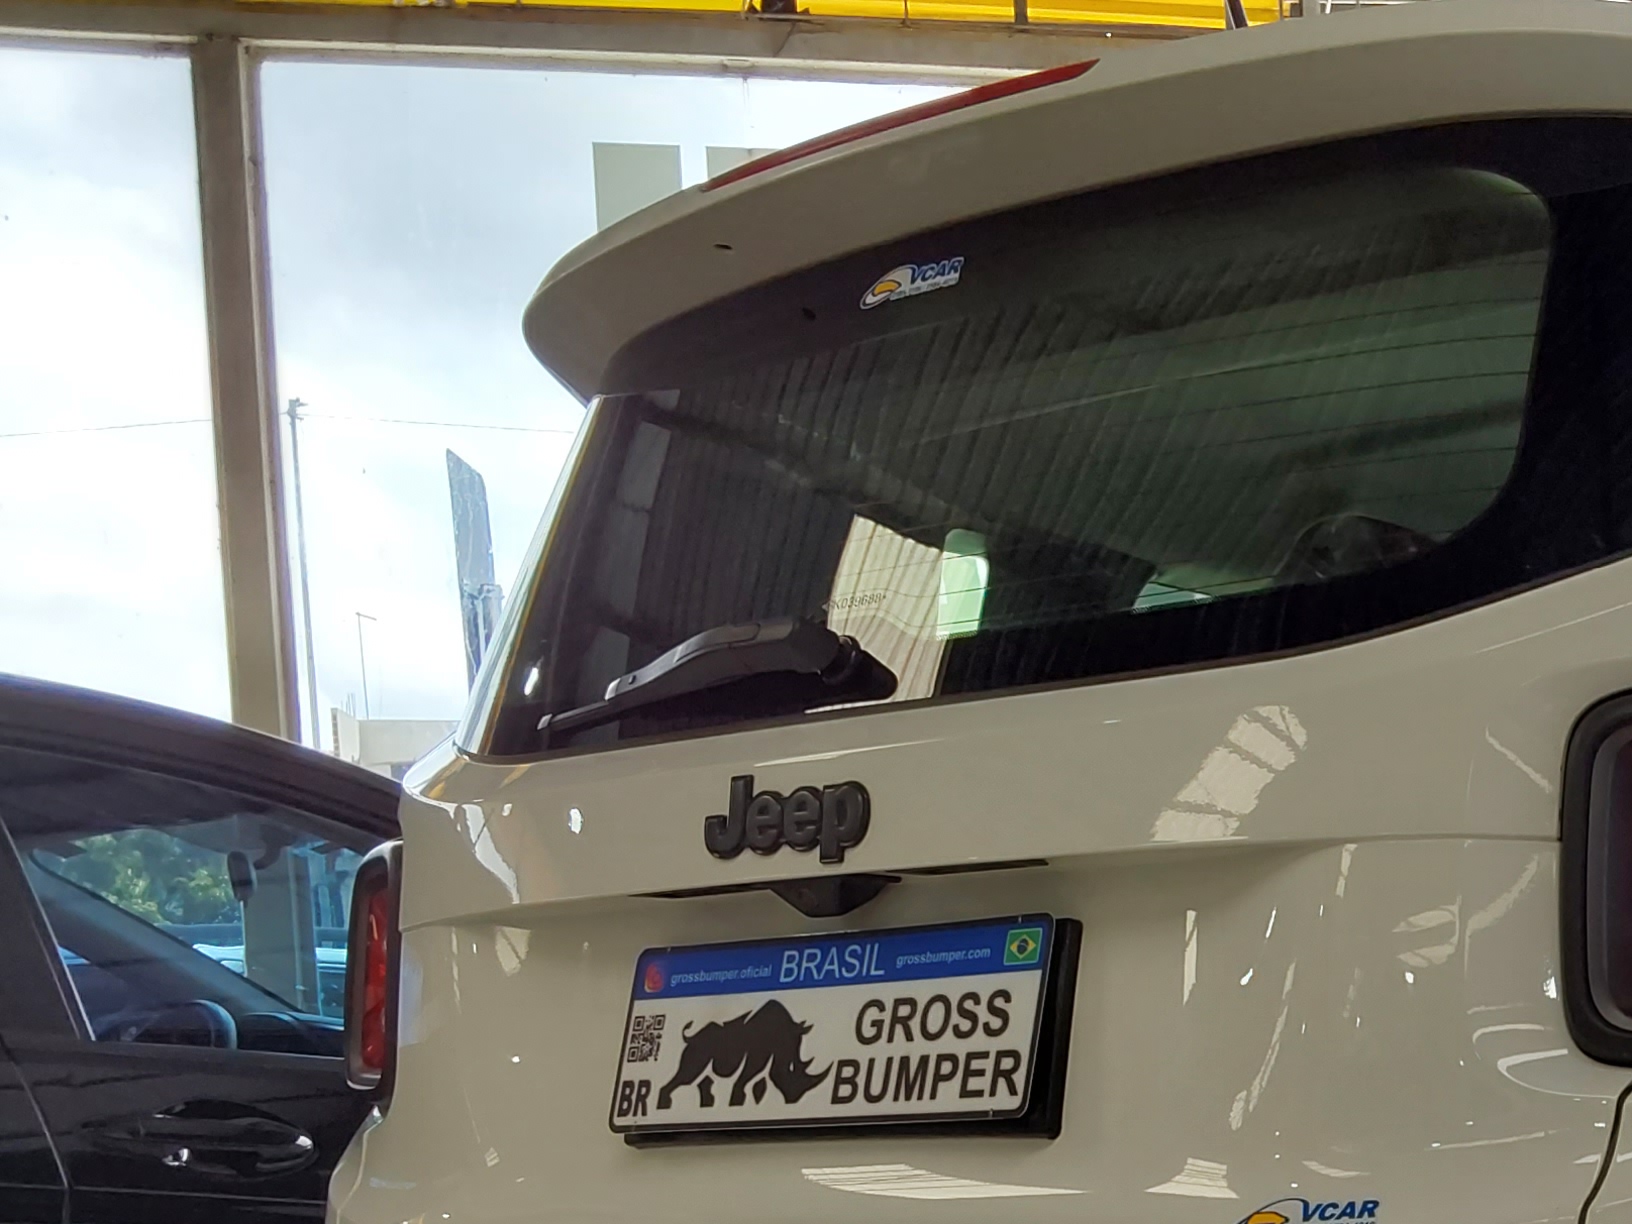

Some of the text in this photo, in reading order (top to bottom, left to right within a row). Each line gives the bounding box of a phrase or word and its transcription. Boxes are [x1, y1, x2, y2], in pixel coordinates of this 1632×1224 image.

[910, 259, 962, 285] VCAR
[704, 774, 871, 864] Jeep
[670, 943, 991, 987] grossbumper.oficial BRASIL grossbumper.com
[855, 989, 1013, 1045] GROSS
[617, 1079, 651, 1118] BR
[830, 1049, 1022, 1105] BUMPER
[1302, 1200, 1380, 1222] VCAR
